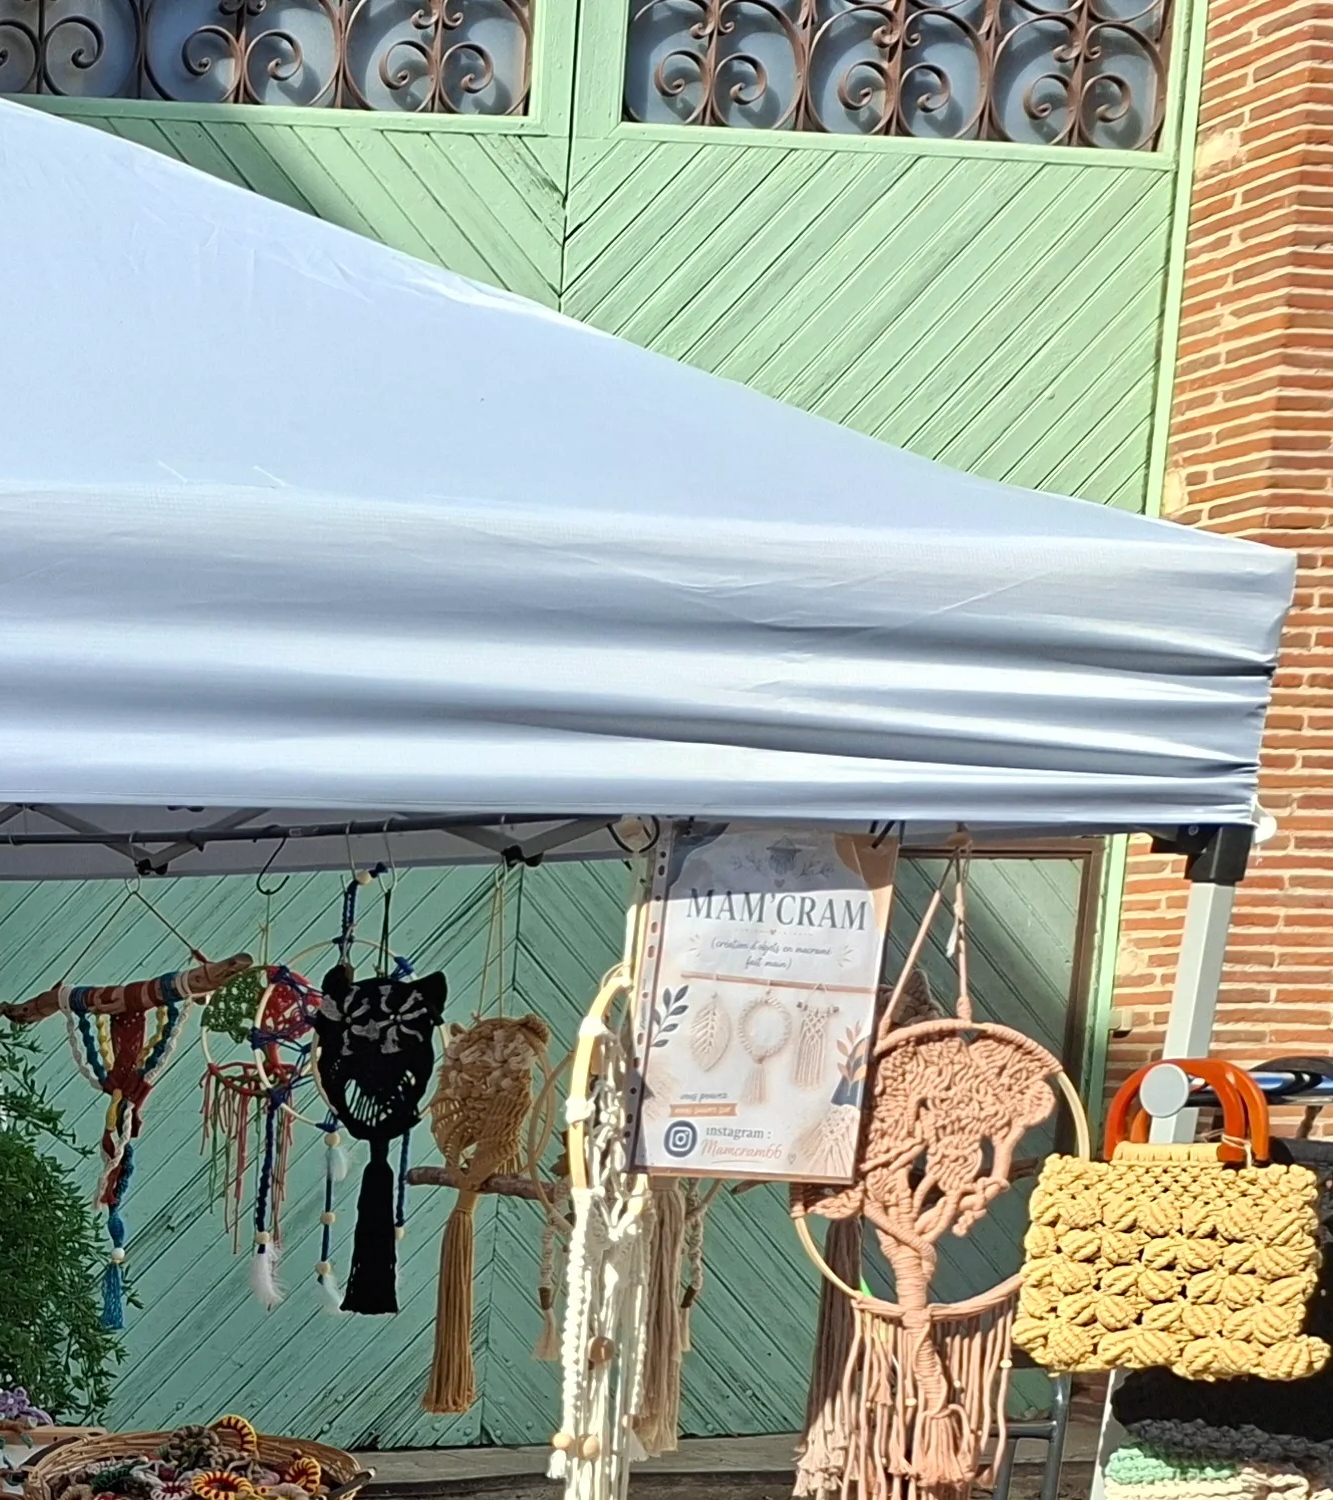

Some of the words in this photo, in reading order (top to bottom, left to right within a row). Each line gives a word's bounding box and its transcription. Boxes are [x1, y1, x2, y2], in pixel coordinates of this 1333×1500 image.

[782, 945, 793, 953] en
[744, 956, 762, 969] fait
[701, 1138, 783, 1159] Mamcram66
